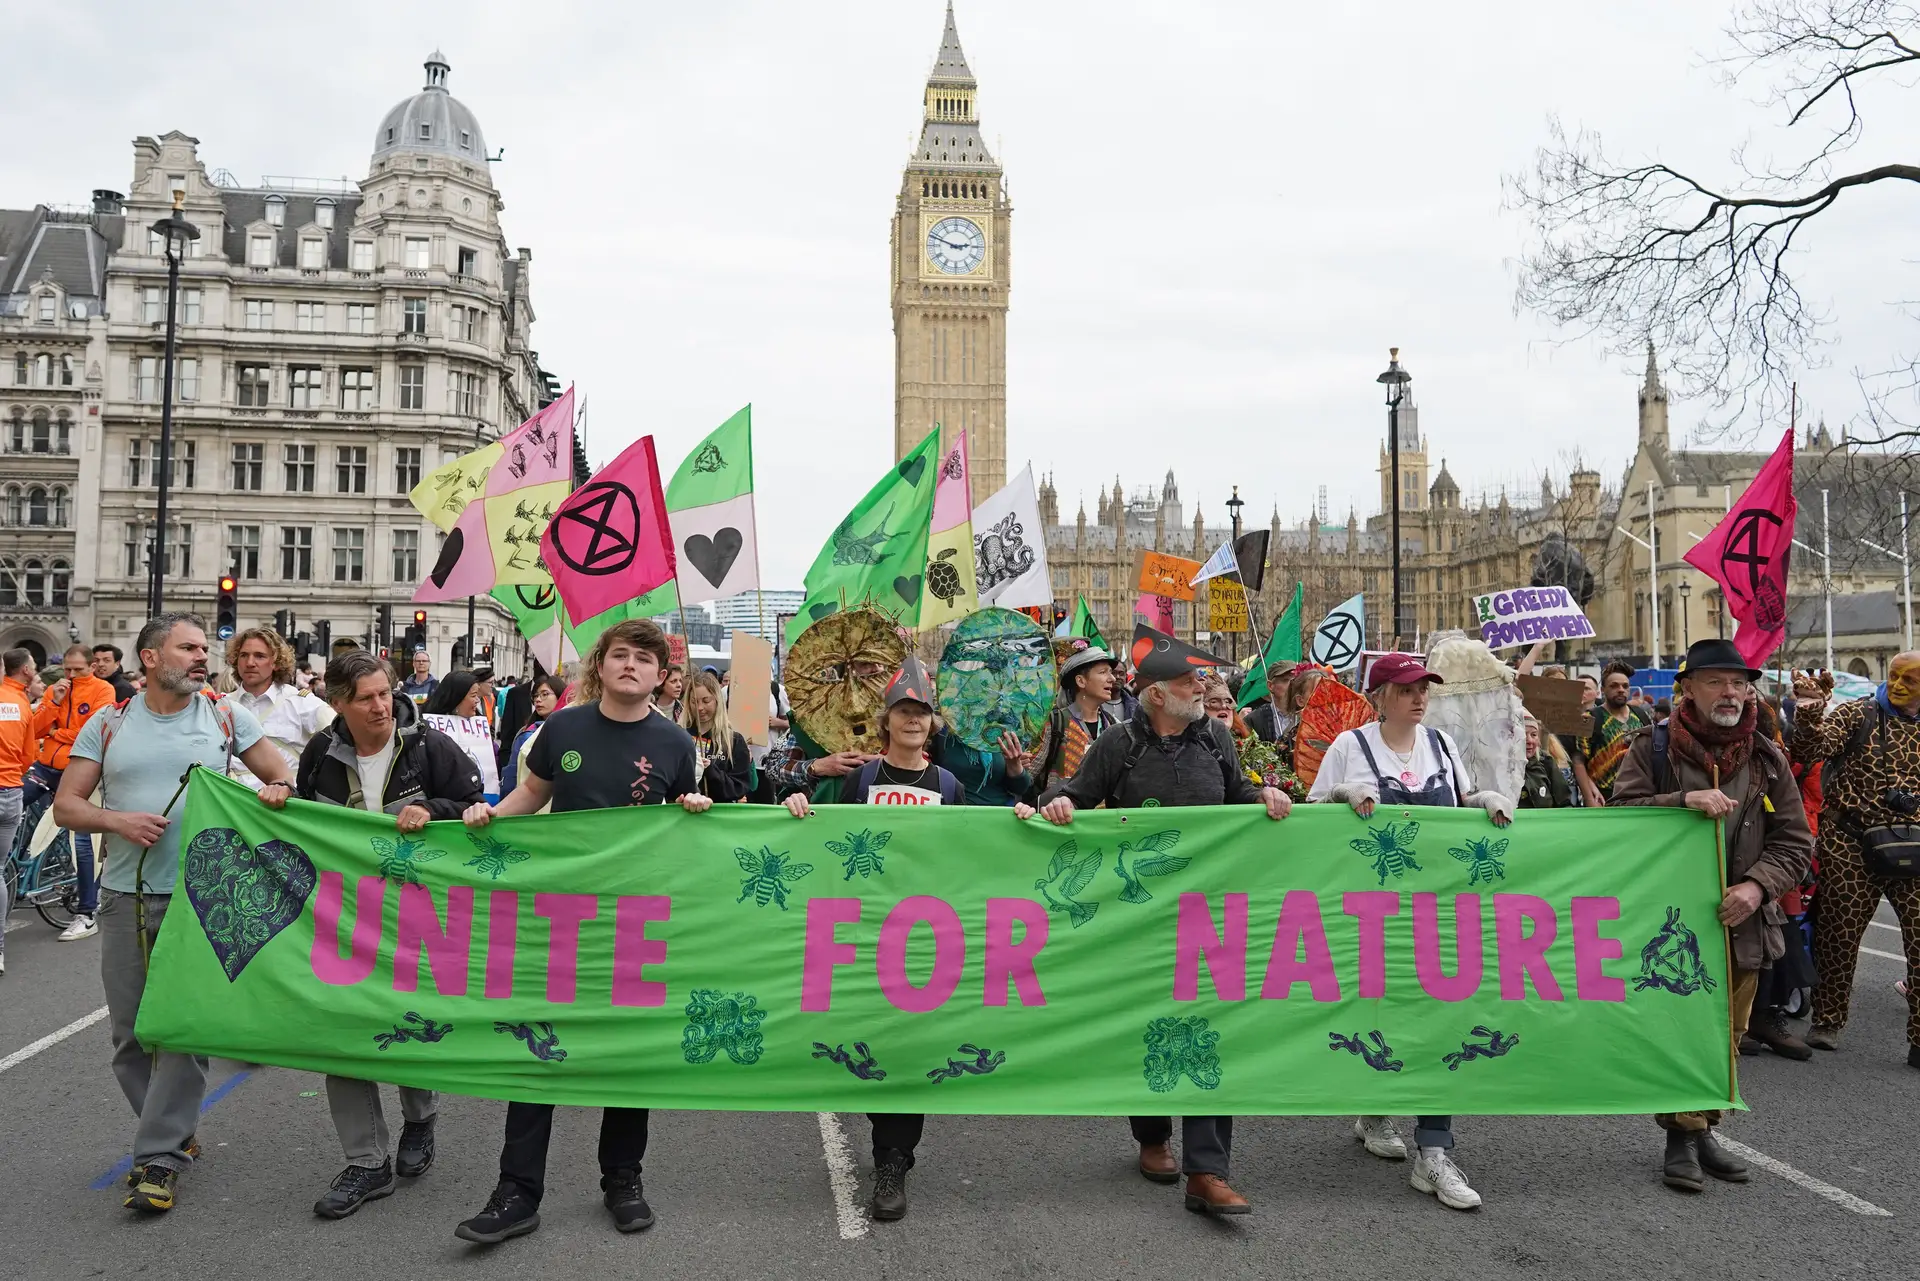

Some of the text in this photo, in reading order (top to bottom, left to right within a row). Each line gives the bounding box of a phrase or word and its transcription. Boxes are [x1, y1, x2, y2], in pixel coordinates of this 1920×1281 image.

[1226, 603, 1246, 614] BUZZ
[1493, 588, 1569, 616] GREEDY
[1216, 616, 1239, 630] OFF!
[1481, 614, 1593, 648] GOVERNMENT
[427, 716, 489, 739] SEA LIFE
[630, 755, 653, 806] 七人の
[310, 871, 1627, 1013] UNITE FOR NATURE
